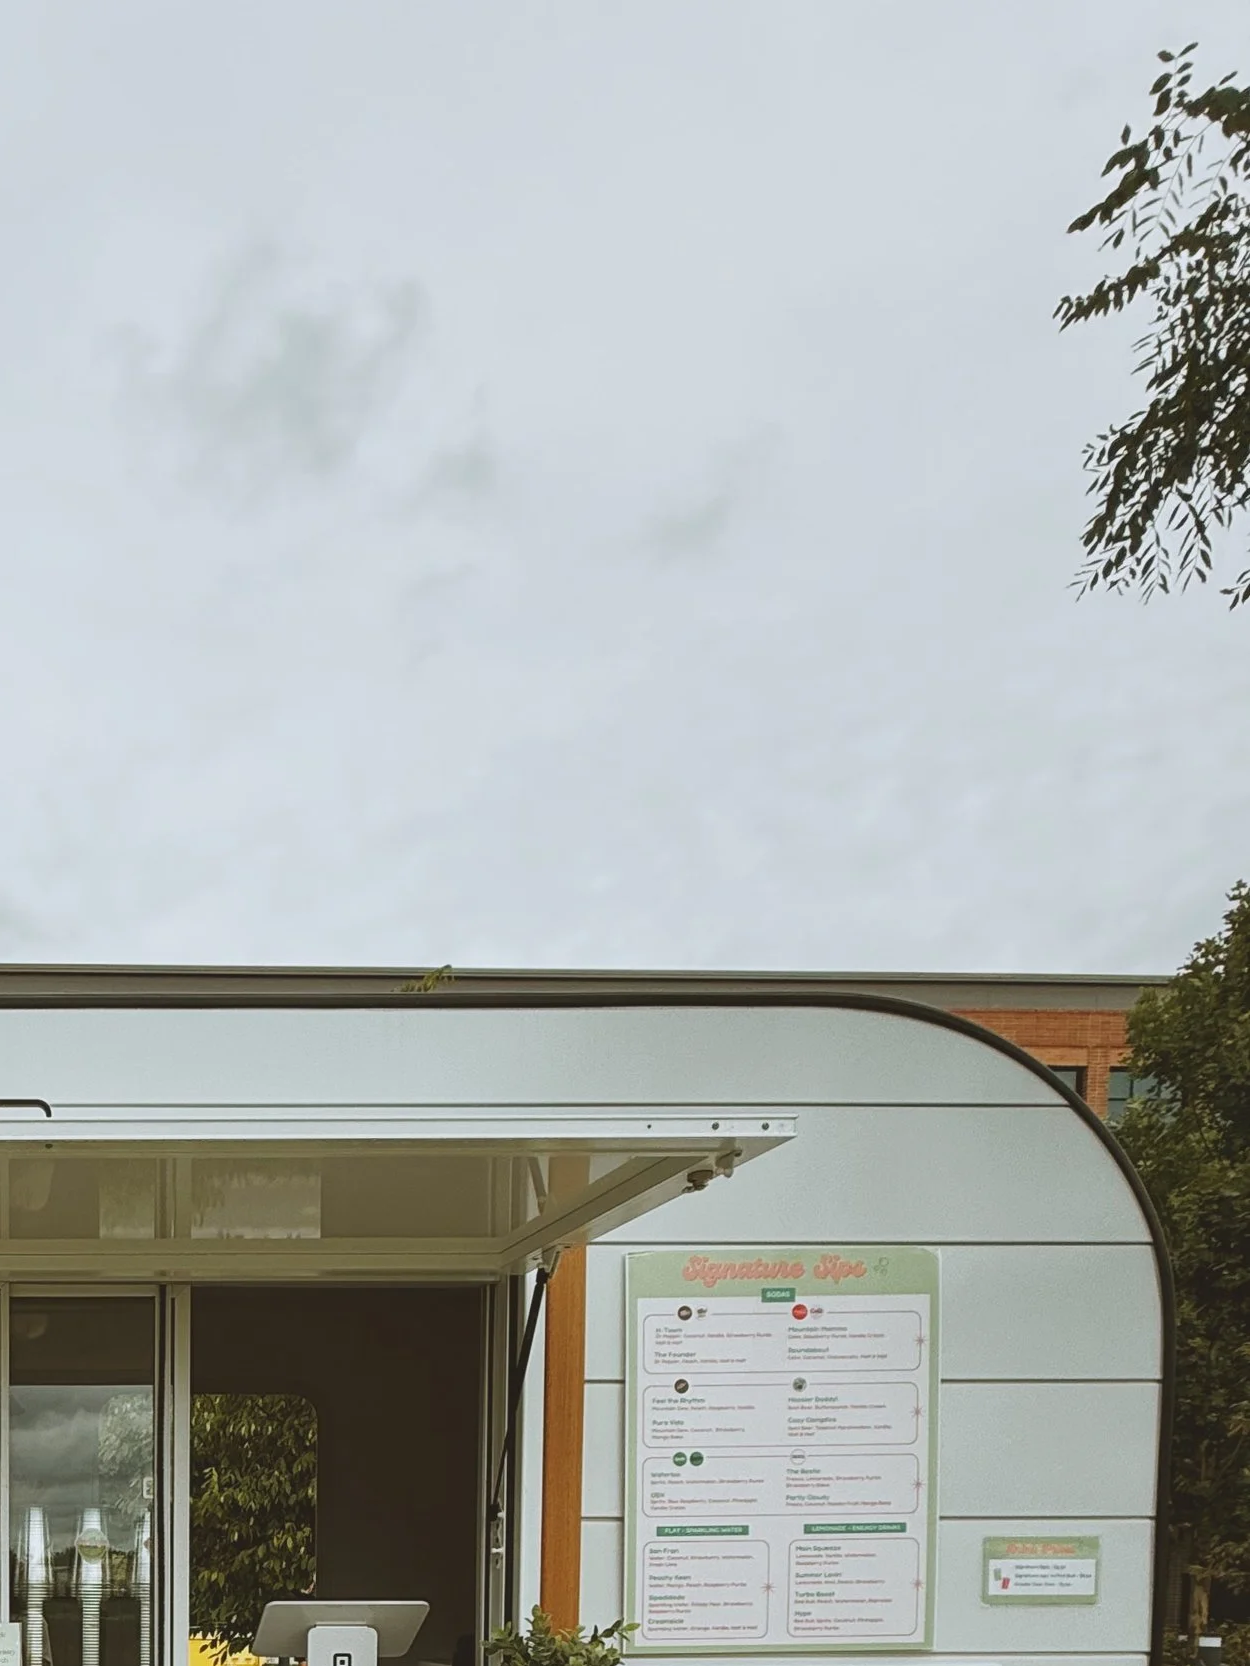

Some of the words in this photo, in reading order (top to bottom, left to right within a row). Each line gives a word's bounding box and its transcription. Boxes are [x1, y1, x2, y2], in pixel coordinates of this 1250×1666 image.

[682, 1255, 805, 1288] Signature
[813, 1254, 867, 1284] Sips
[765, 1290, 791, 1299] SODAS
